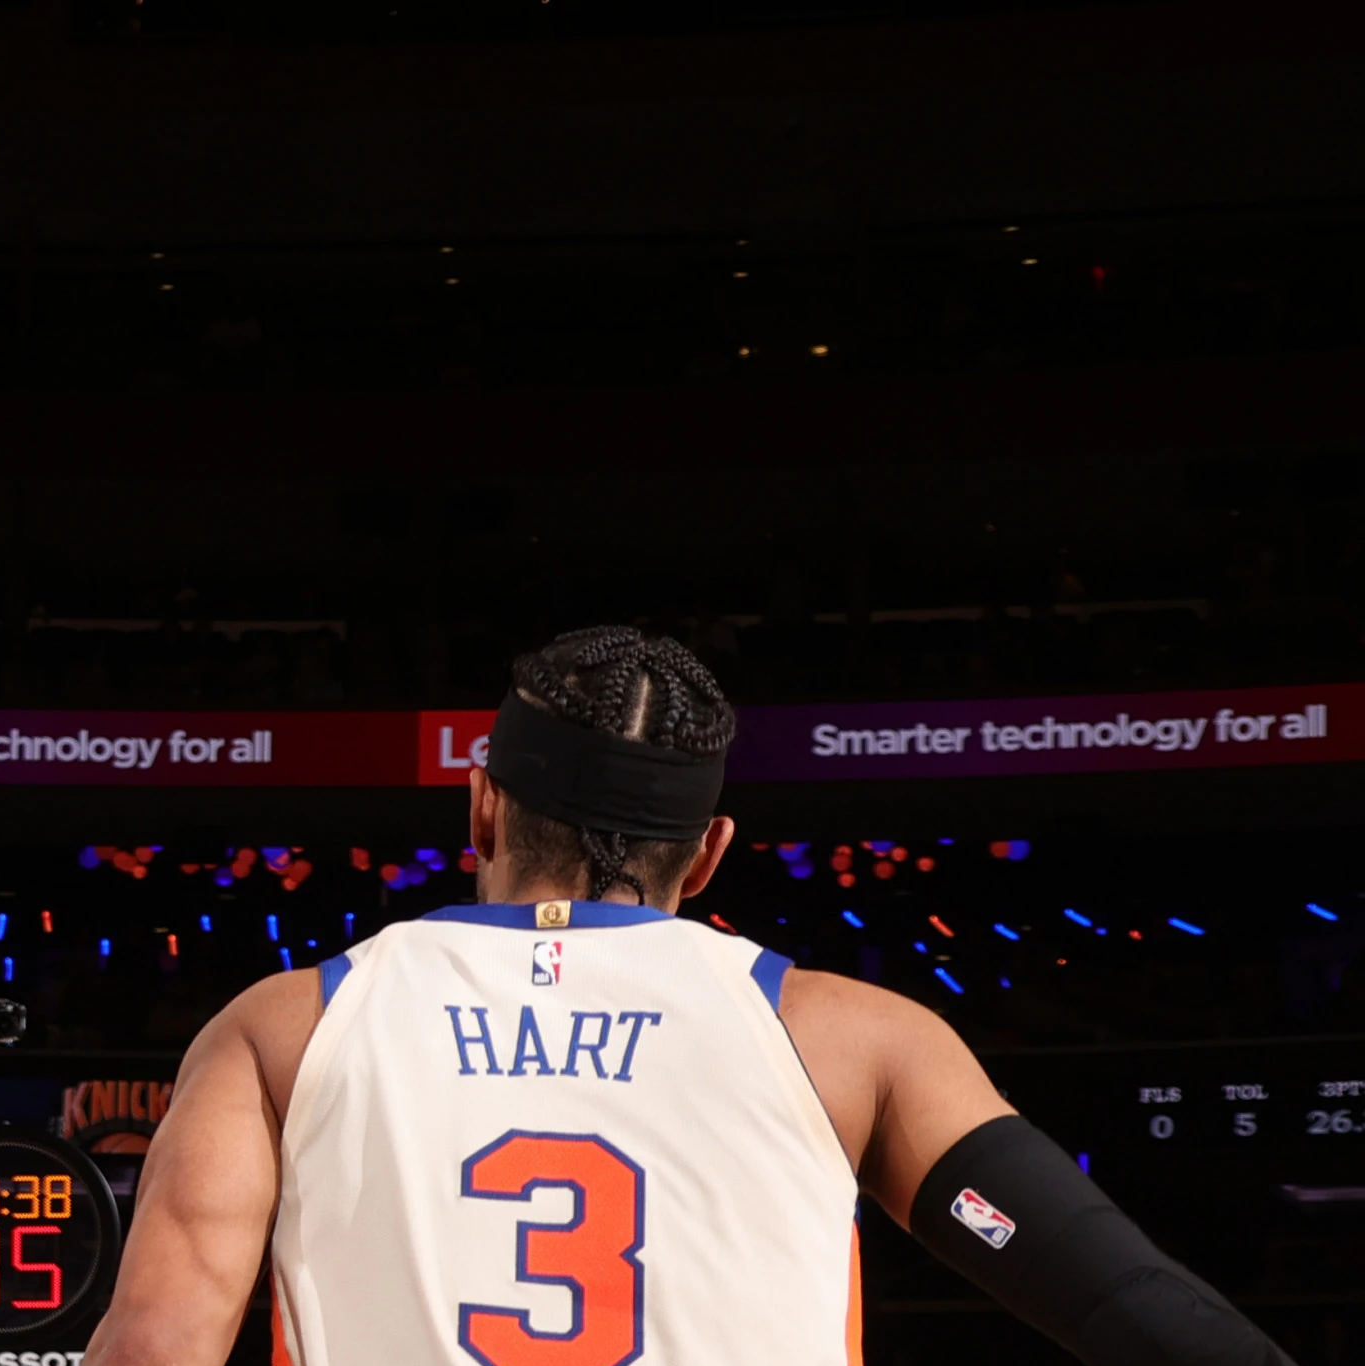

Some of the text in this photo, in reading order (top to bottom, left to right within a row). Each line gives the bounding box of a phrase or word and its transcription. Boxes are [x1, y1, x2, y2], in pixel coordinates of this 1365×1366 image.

[168, 729, 225, 763] for
[228, 729, 273, 763] all
[812, 703, 1328, 756] Smarter technology for all
[445, 1005, 662, 1082] HART
[63, 1079, 175, 1139] KNICK
[1138, 1080, 1365, 1104] FLS TOL 3PT
[1149, 1114, 1175, 1139] 0
[1233, 1111, 1258, 1138] 5
